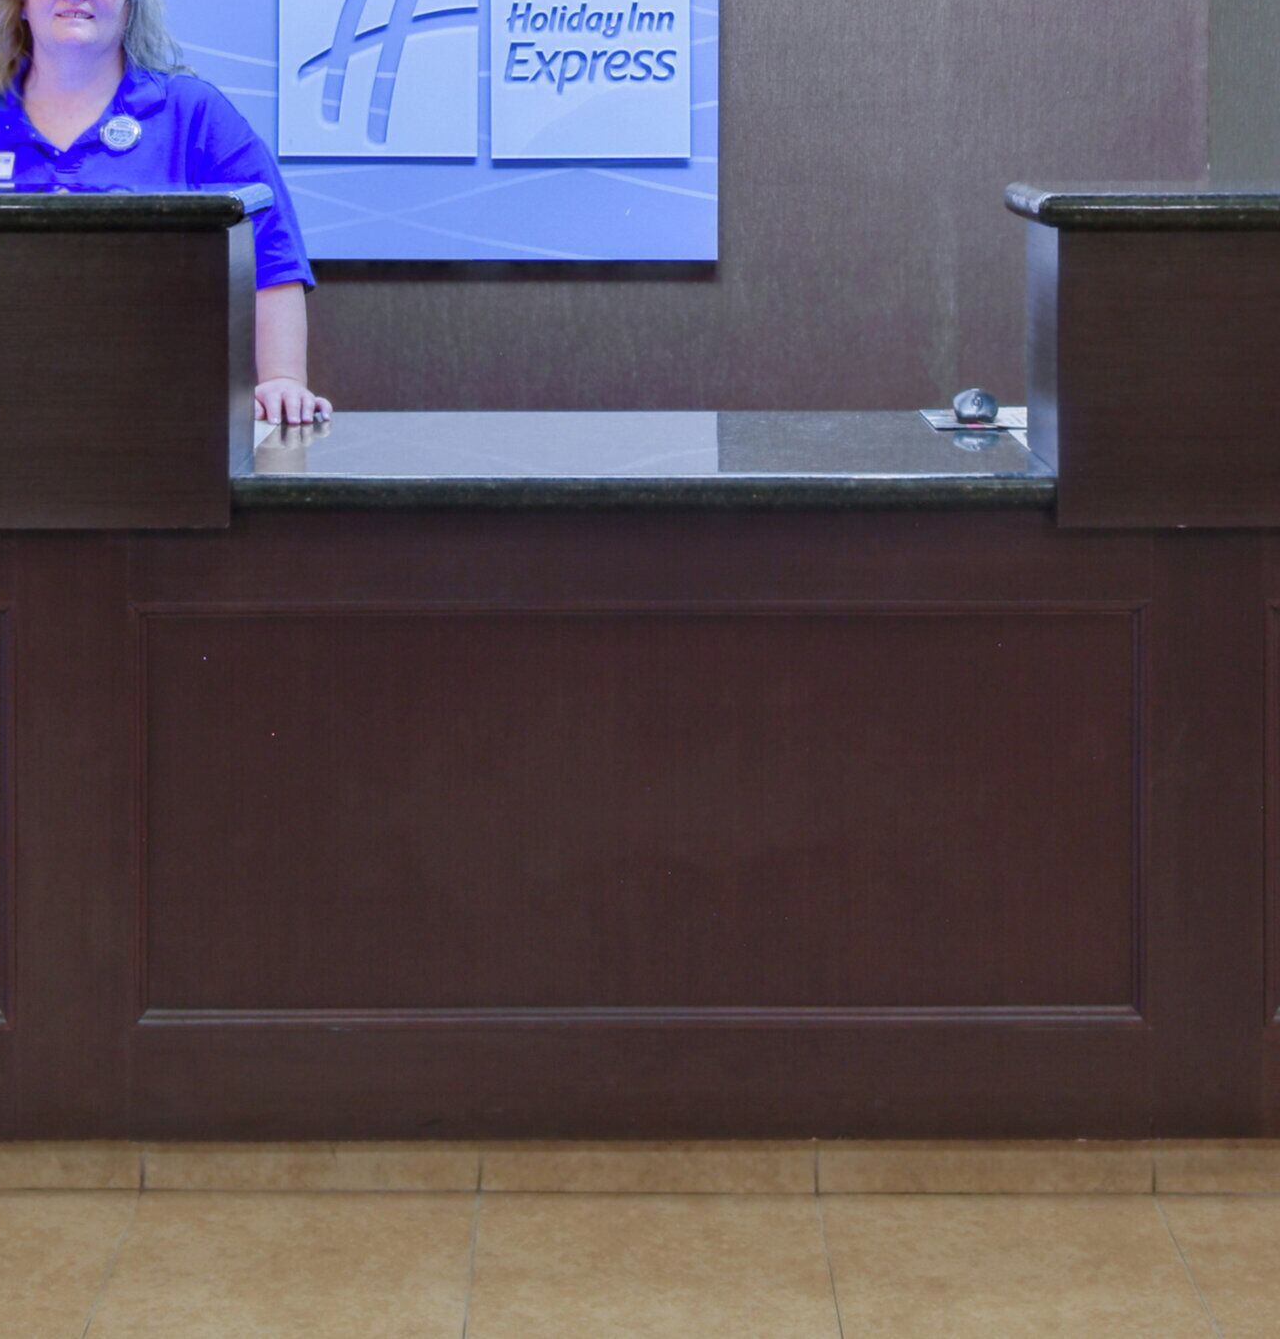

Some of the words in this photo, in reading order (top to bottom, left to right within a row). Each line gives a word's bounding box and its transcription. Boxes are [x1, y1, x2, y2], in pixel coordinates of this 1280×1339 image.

[506, 2, 624, 39] Holiday
[628, 1, 675, 32] Inn
[504, 42, 677, 95] Express
